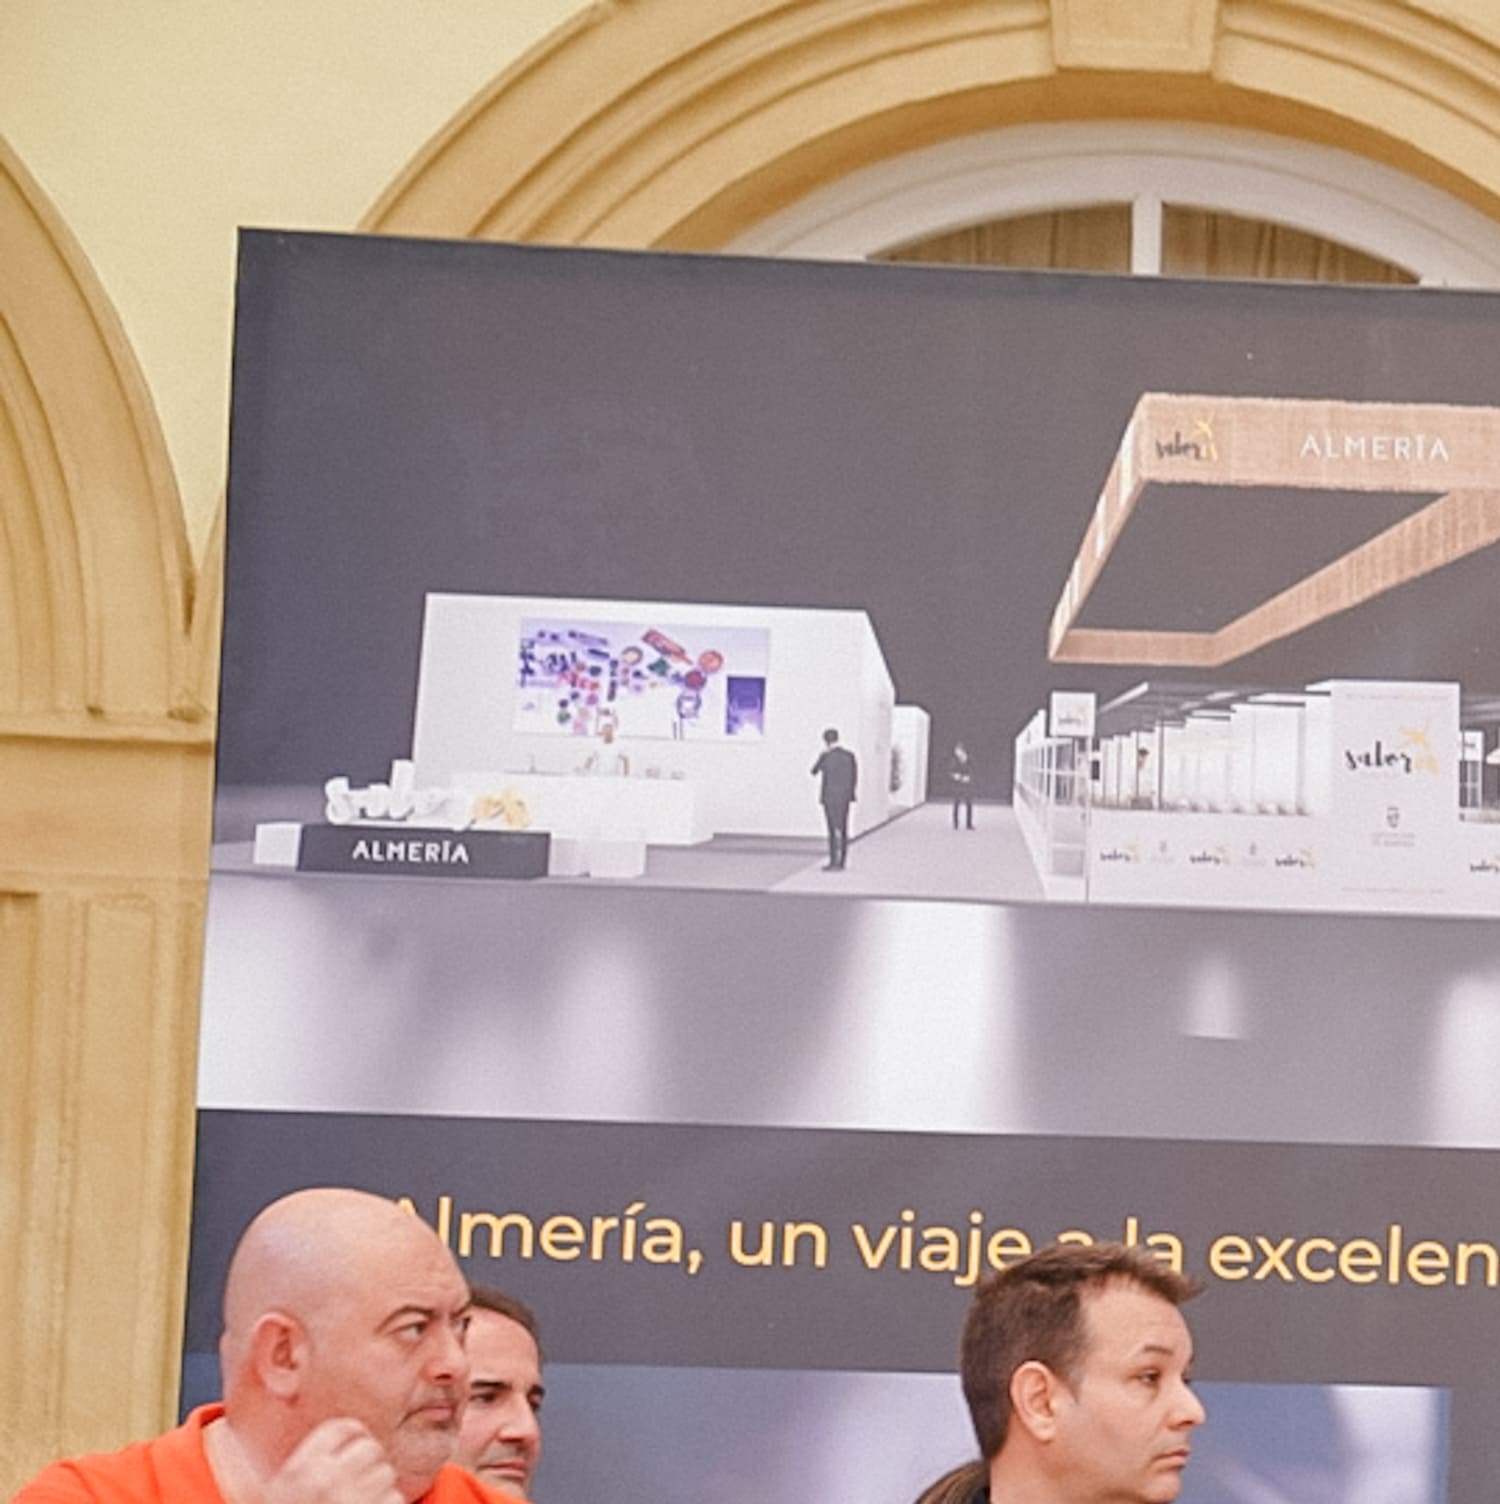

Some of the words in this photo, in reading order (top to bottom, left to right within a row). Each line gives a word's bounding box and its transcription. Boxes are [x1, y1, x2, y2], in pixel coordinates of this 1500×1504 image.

[398, 1196, 703, 1275] lmería,
[730, 1220, 829, 1268] un
[851, 1209, 1032, 1287] viaje
